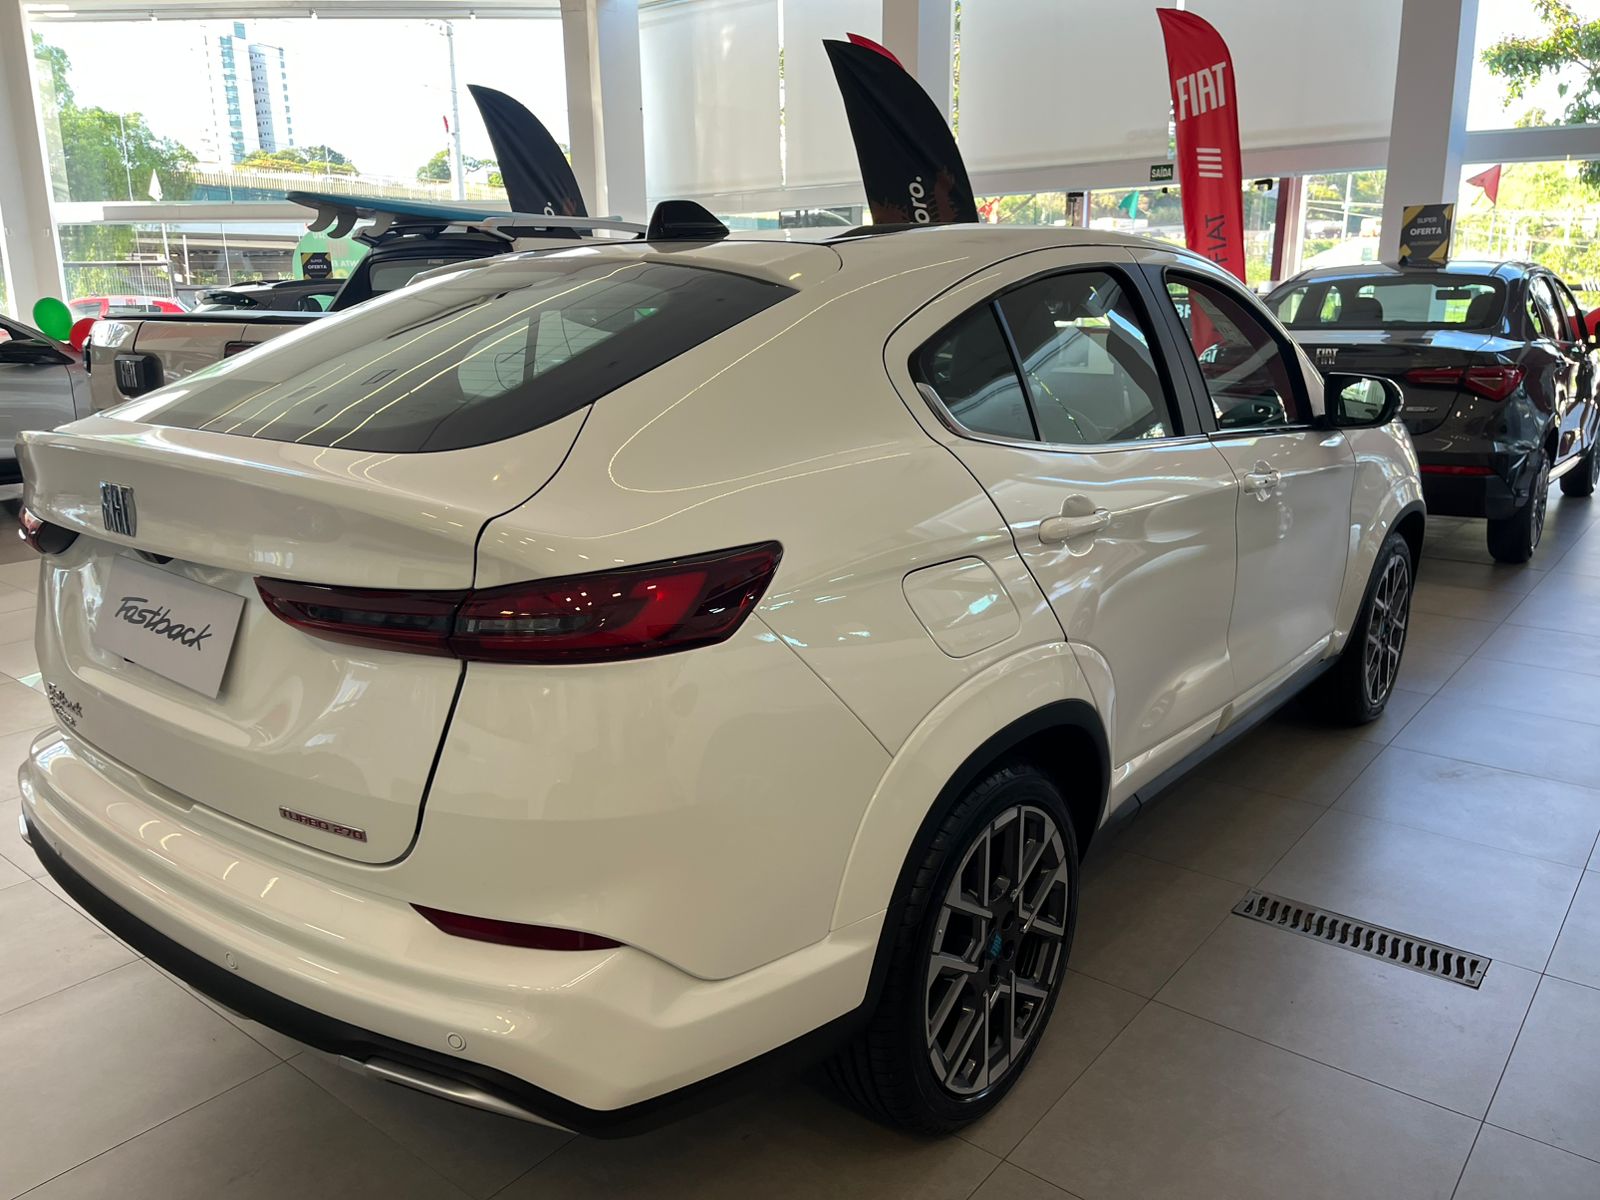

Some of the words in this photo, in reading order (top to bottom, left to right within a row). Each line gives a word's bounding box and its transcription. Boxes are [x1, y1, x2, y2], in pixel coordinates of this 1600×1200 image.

[1176, 61, 1226, 121] FIAT
[1151, 166, 1172, 178] SAÍDA
[908, 175, 930, 223] oro.
[1205, 214, 1228, 263] FIAT
[1410, 227, 1442, 236] OFERTA
[1315, 347, 1339, 365] FIAT
[114, 596, 212, 651] Fastback
[280, 807, 330, 831] TURBO
[333, 822, 365, 841] 270
